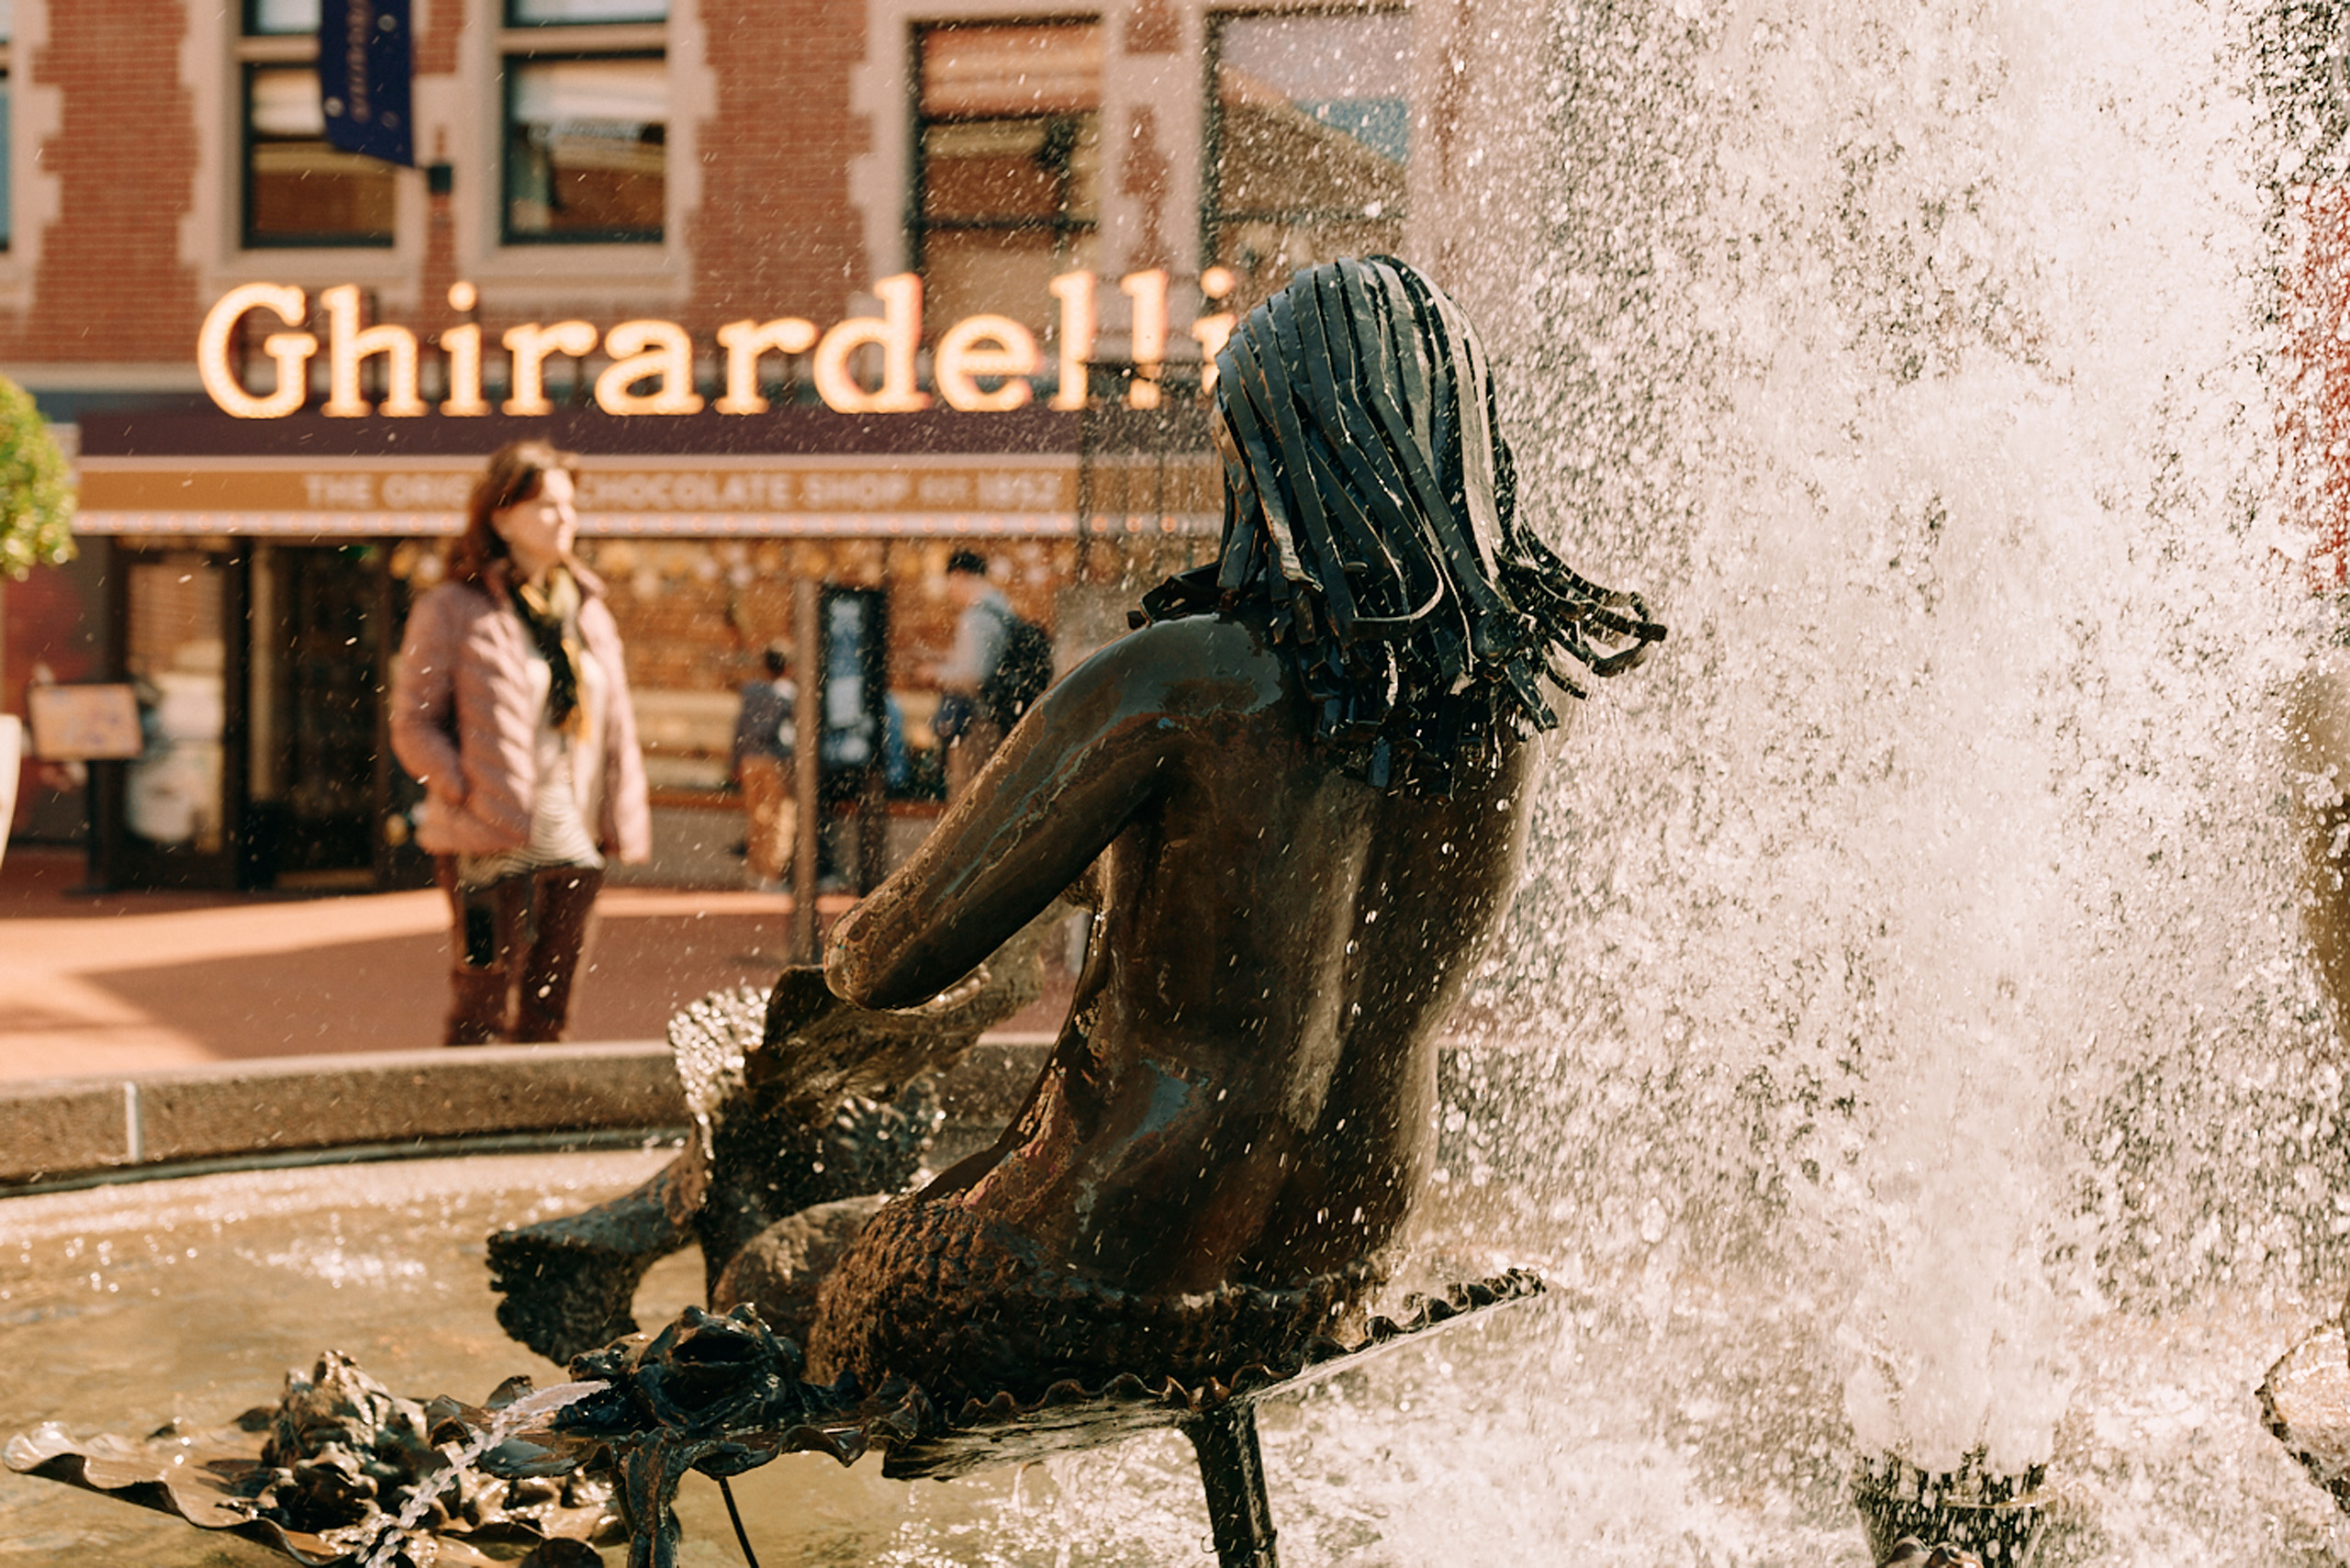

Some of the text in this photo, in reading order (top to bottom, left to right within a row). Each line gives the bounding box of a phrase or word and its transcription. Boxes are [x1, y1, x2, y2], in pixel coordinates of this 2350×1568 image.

[305, 474, 372, 507] THE
[382, 474, 470, 508] ORIG
[576, 473, 793, 508] CHOCOLATE
[802, 473, 911, 508] SHOP
